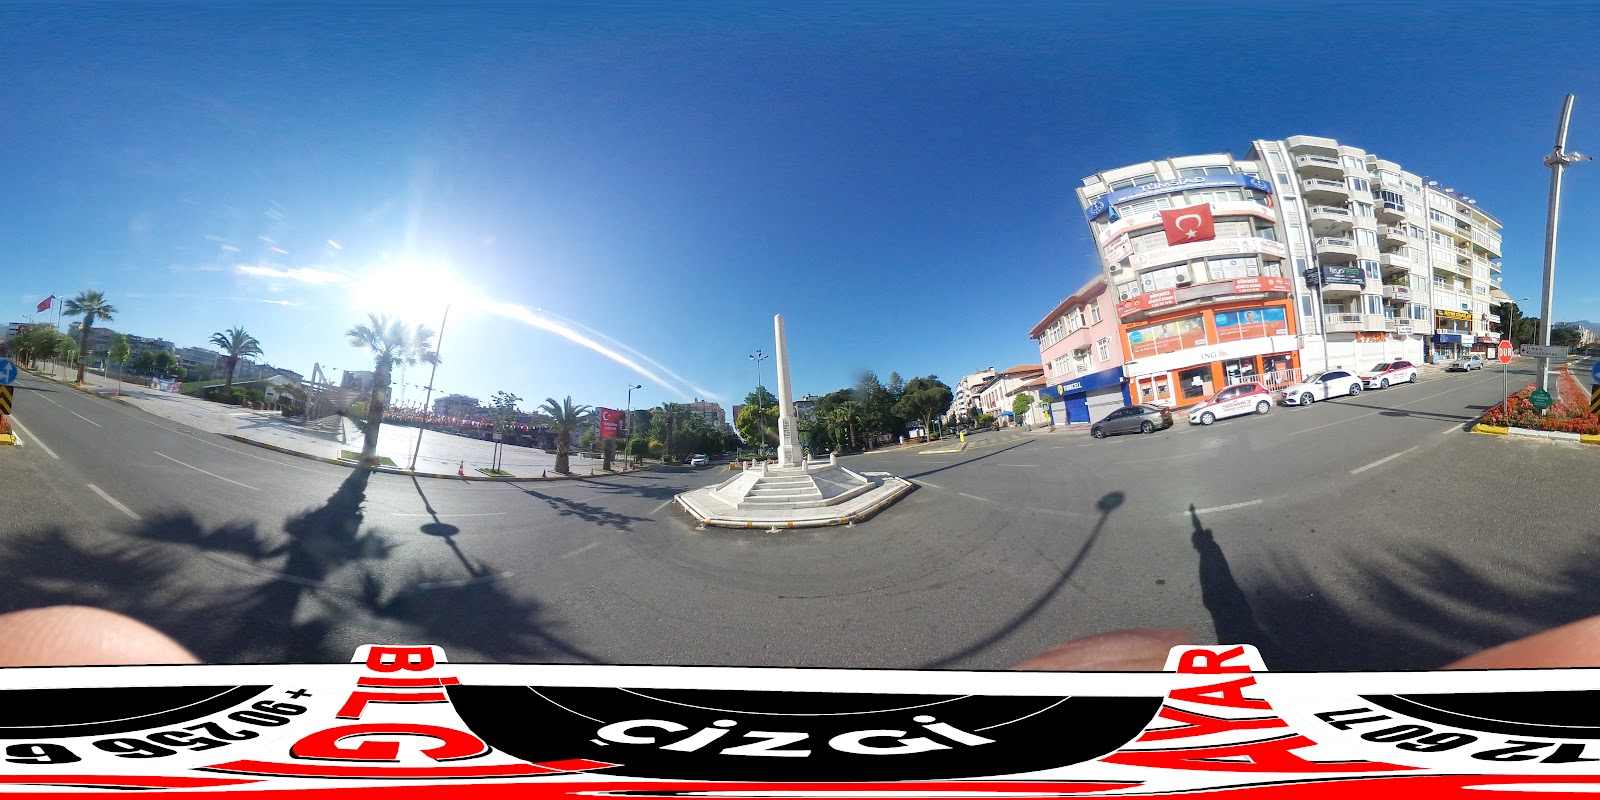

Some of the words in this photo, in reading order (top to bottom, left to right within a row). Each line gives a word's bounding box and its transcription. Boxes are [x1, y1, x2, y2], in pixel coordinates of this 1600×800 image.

[1139, 176, 1206, 192] TÜMSİAD
[1200, 351, 1217, 360] ING
[1499, 347, 1512, 357] DUR
[1063, 382, 1082, 392] TURKCELL
